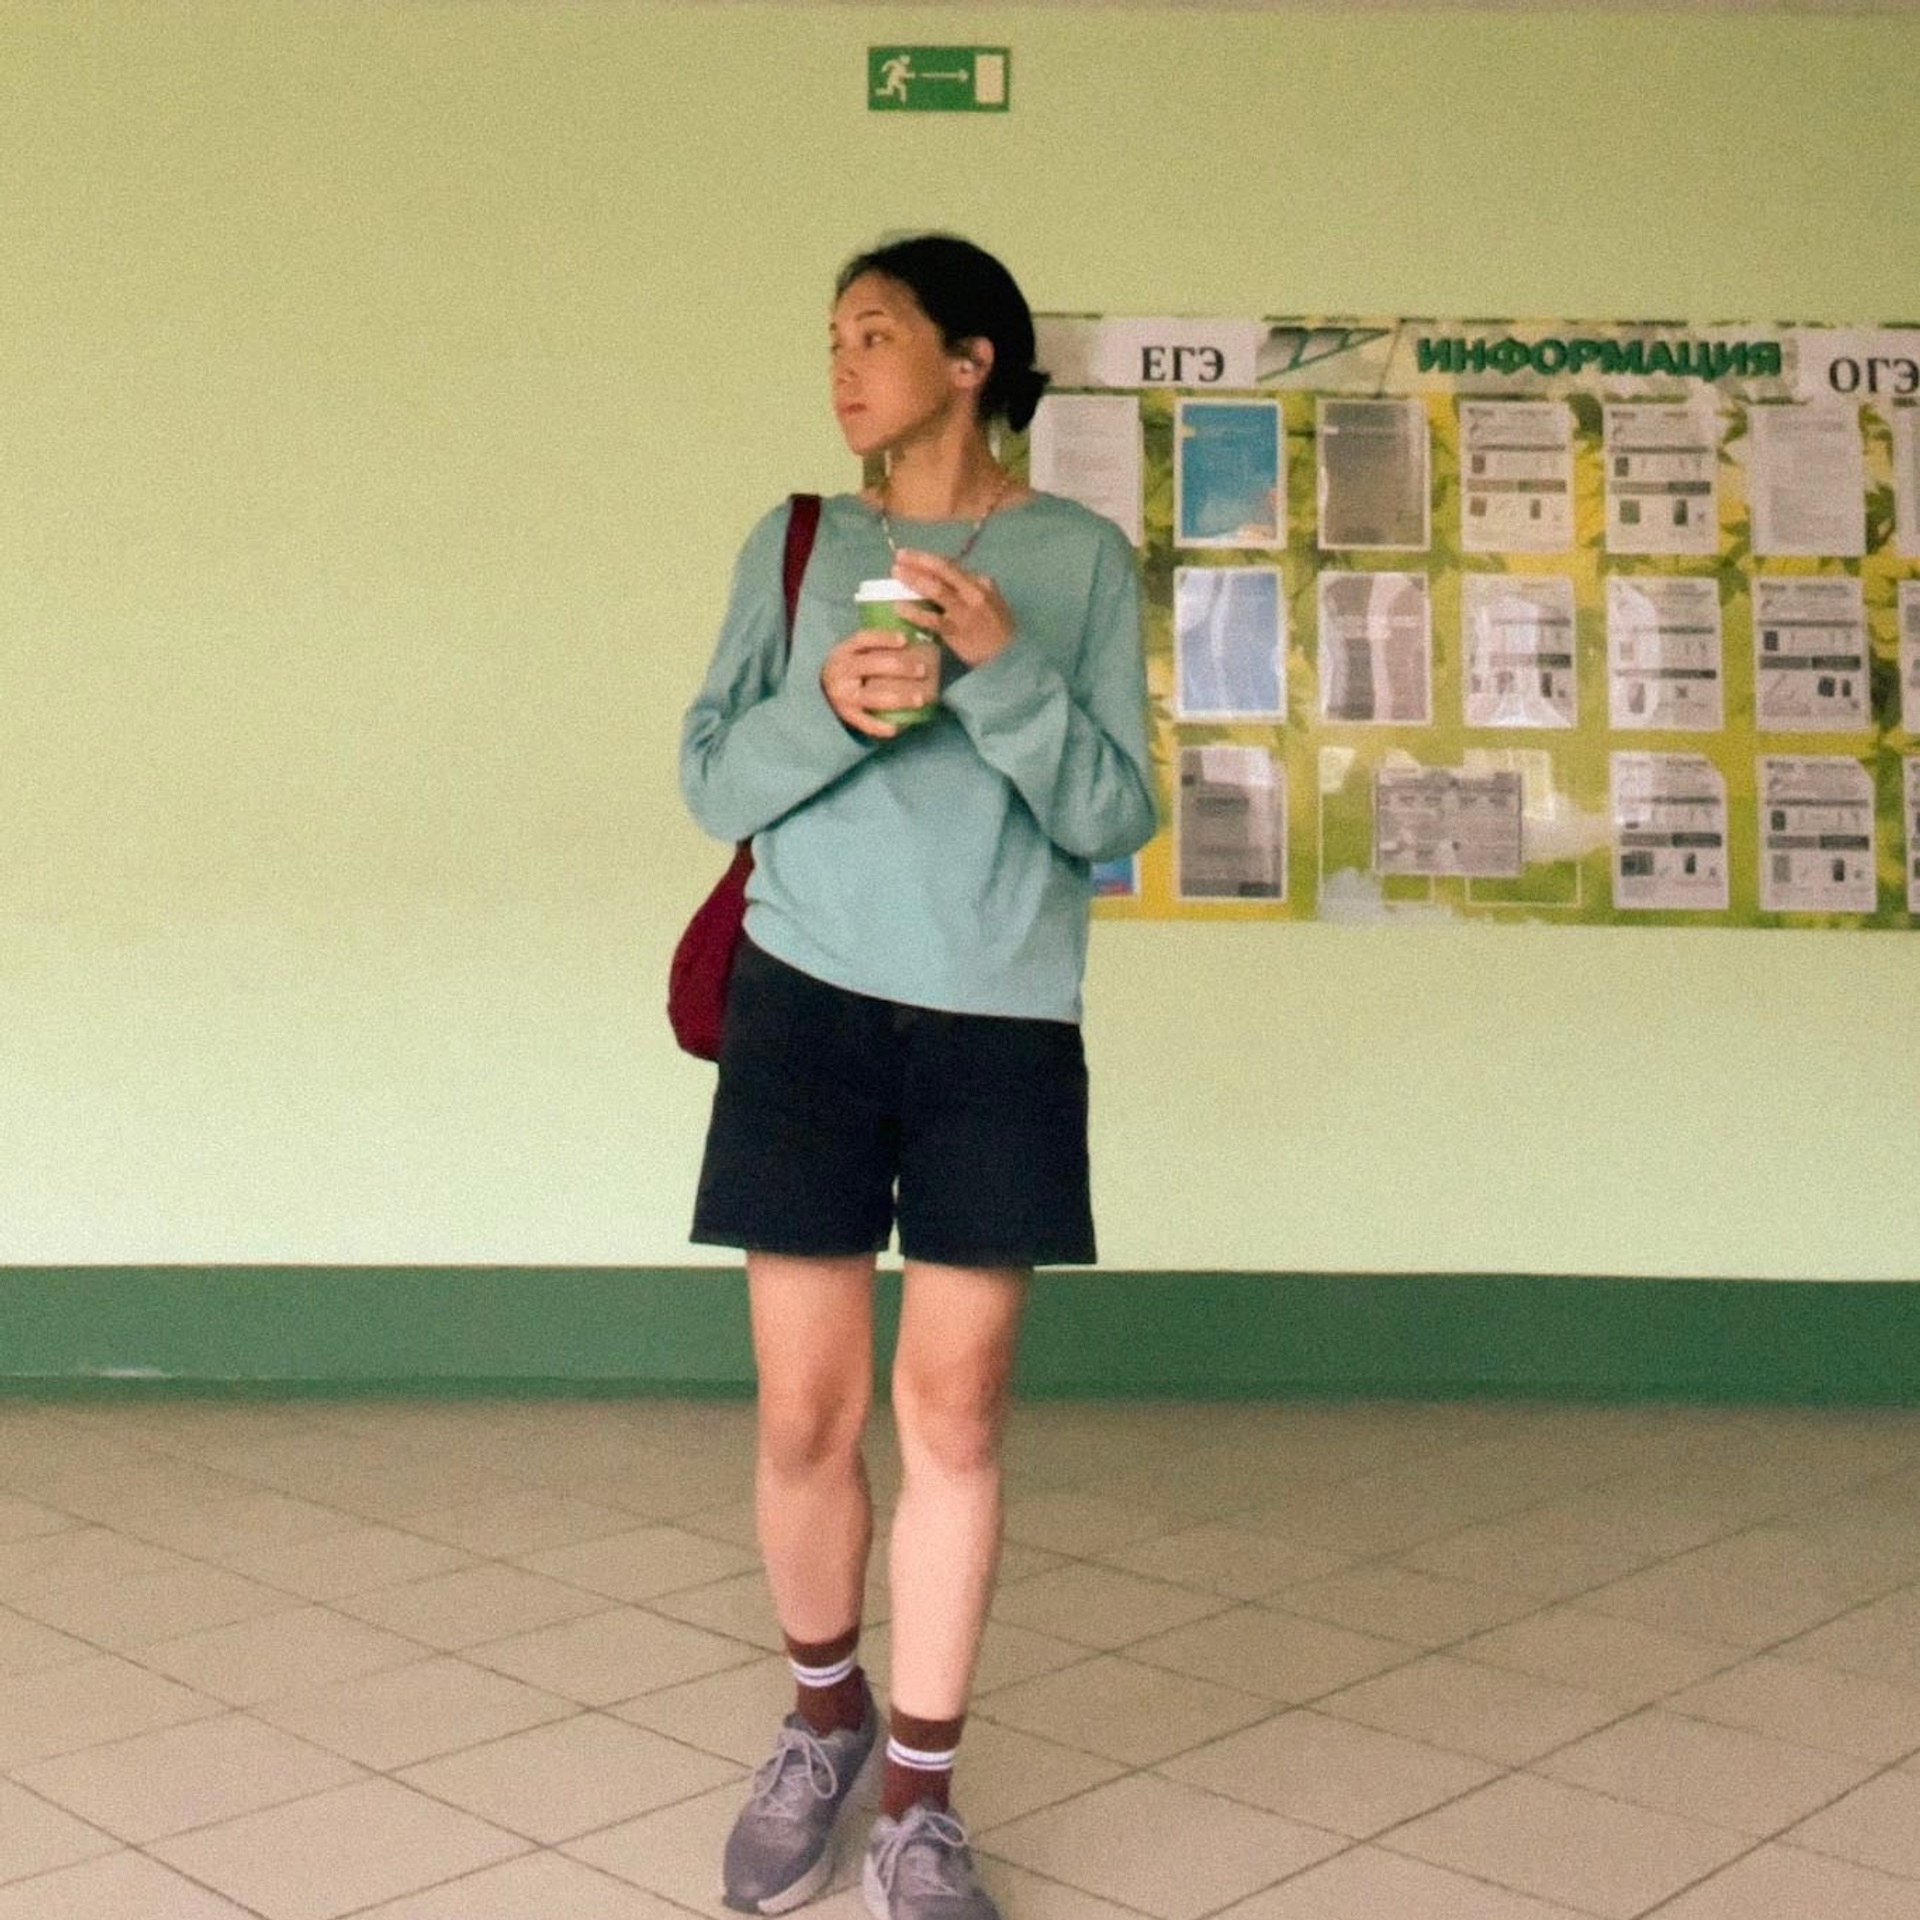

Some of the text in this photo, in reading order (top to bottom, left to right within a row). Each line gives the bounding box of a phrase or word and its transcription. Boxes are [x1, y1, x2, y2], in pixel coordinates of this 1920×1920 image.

[1142, 346, 1225, 382] ЕГЭ
[1416, 337, 1781, 382] ИНФОРМАЦИЯ
[1829, 357, 1919, 394] ОГЭ
